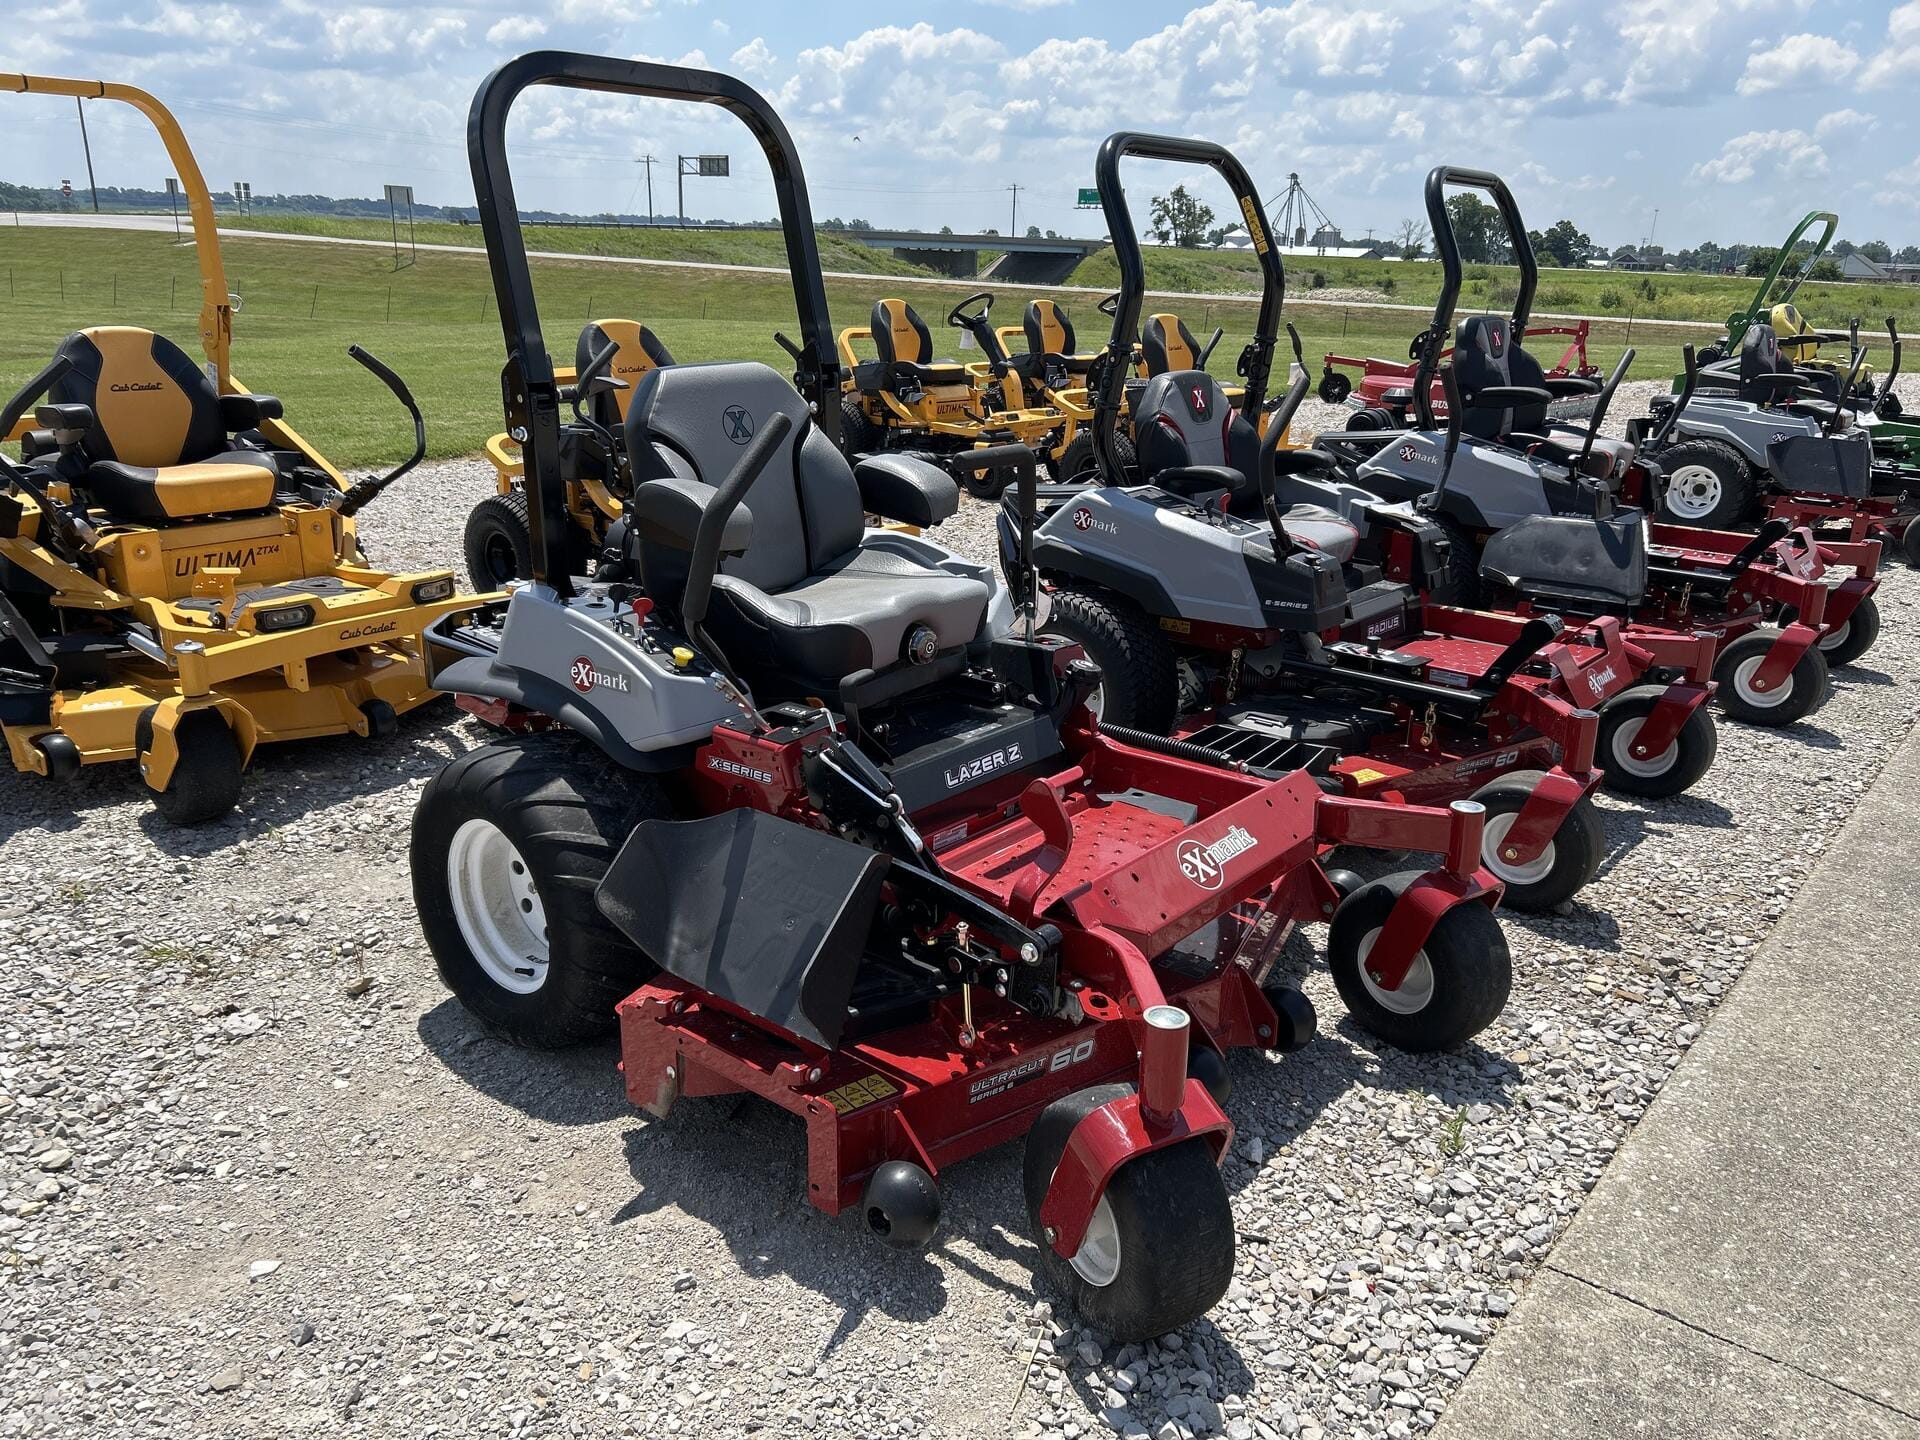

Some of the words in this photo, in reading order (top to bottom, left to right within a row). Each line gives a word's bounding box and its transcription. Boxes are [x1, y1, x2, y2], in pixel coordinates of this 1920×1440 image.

[110, 383, 129, 392] Cub
[130, 382, 163, 391] Cadet
[1399, 446, 1439, 465] eXmark
[1073, 510, 1118, 535] eXmark
[175, 548, 256, 577] ULTIMA
[256, 544, 280, 556] ZTX4
[340, 627, 361, 640] Cub
[362, 621, 397, 636] Cadet
[1367, 616, 1400, 637] RADIUS
[571, 661, 629, 692] eXmark
[709, 758, 773, 783] X-SERIES
[945, 751, 1006, 788] LAZER
[1007, 744, 1021, 762] Z
[1181, 825, 1257, 884] eXmark
[970, 1057, 1047, 1094] ULTRACUT
[1050, 1038, 1095, 1073] 60
[969, 1085, 1006, 1104] SERIES
